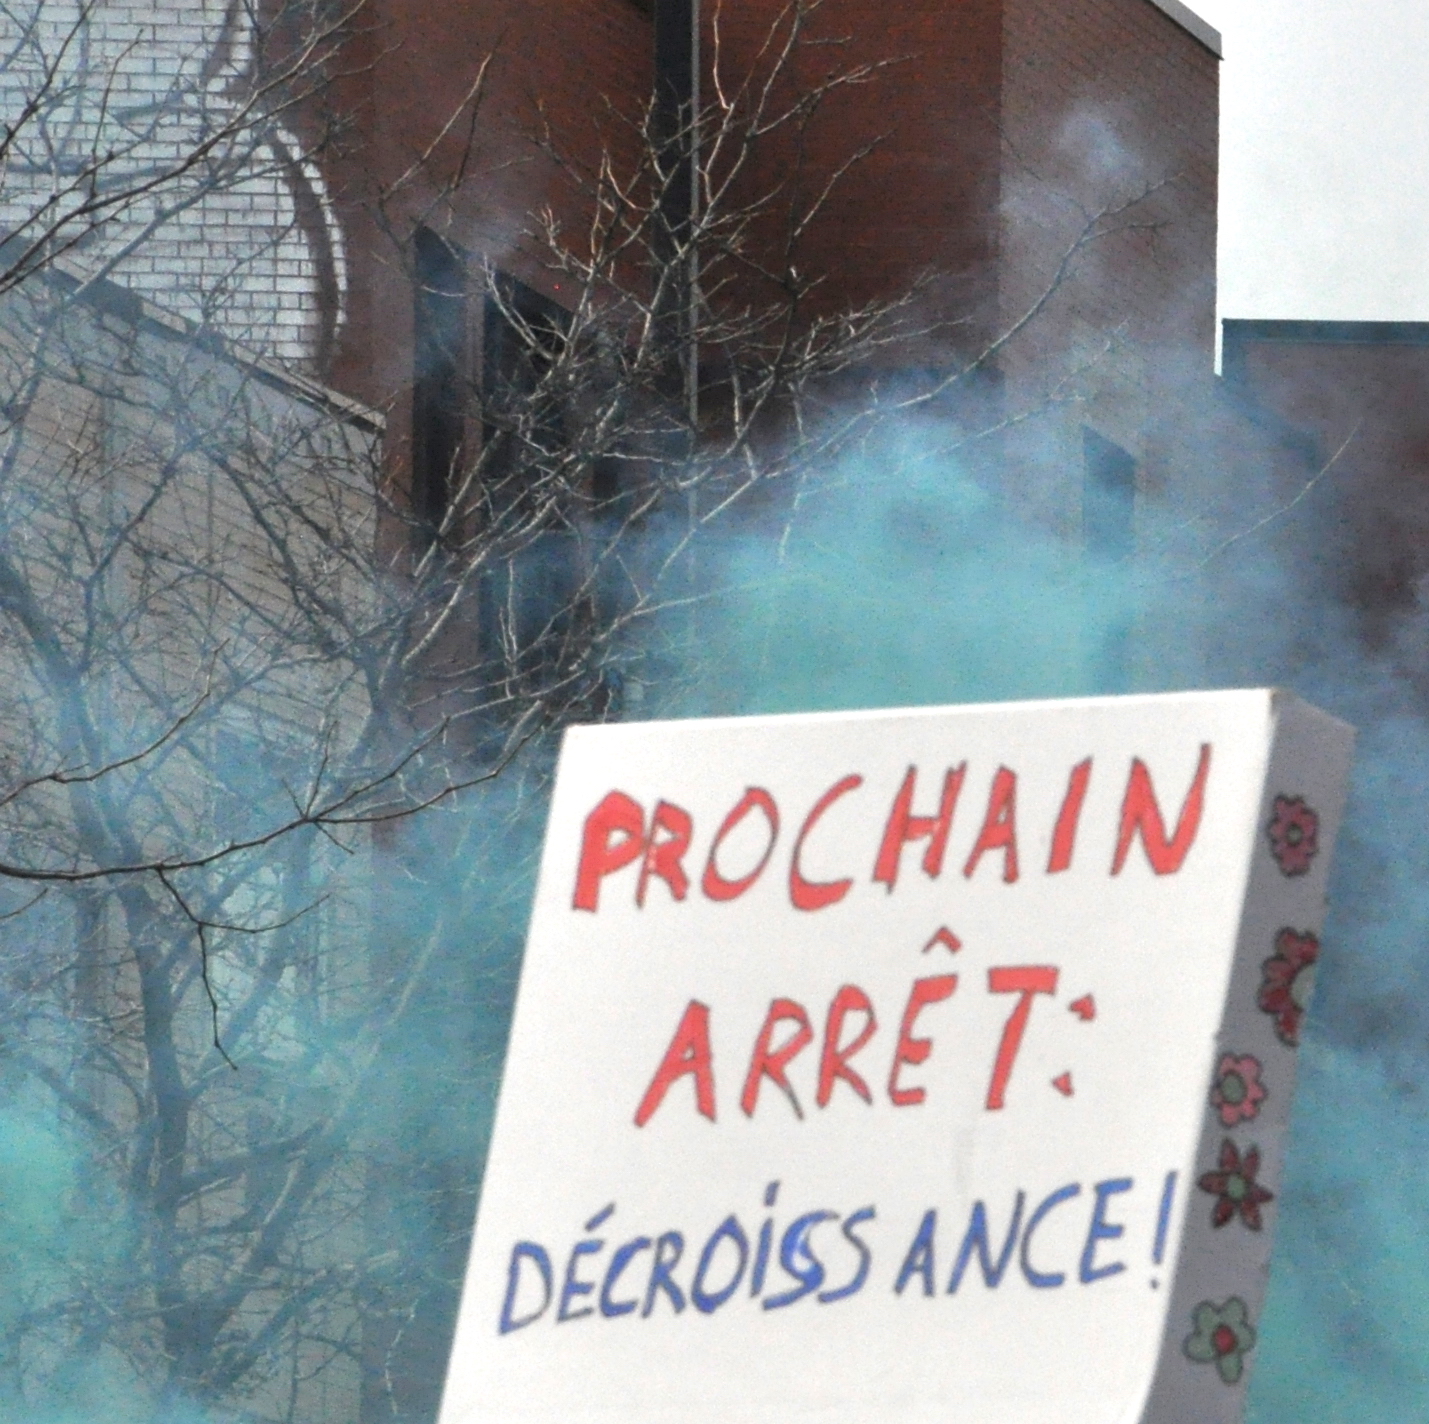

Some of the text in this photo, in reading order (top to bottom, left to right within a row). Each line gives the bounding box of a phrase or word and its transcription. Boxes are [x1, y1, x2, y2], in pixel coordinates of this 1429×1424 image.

[572, 742, 1213, 912] PROCHAIN
[634, 926, 1096, 1127] ARRÊT:
[499, 1169, 1181, 1336] DÉCROISSANCE!
